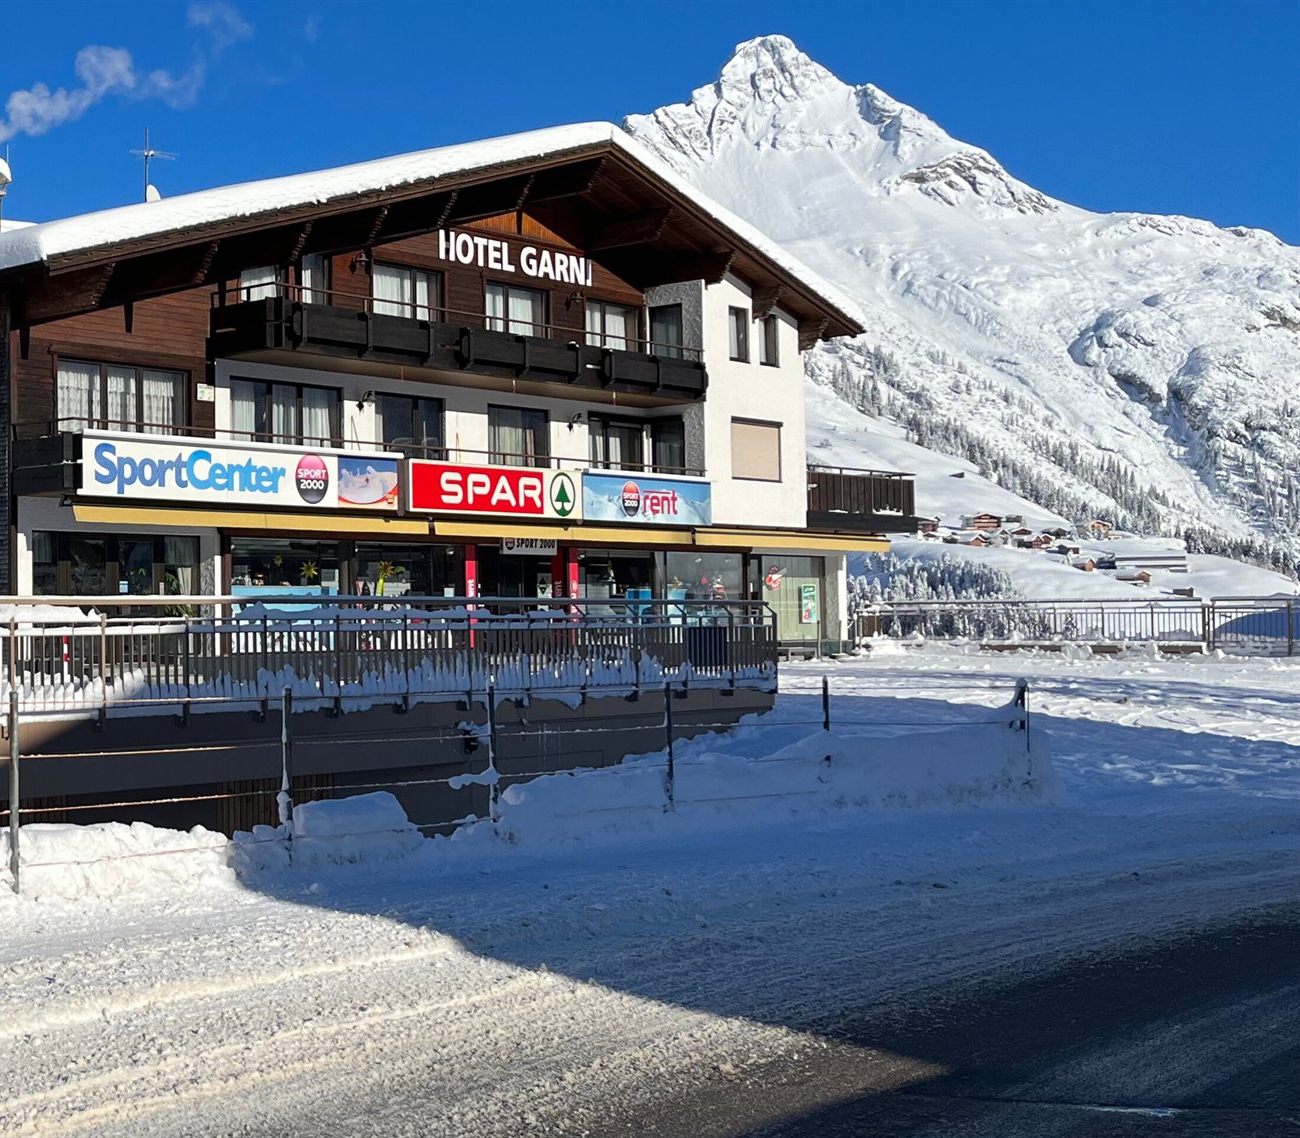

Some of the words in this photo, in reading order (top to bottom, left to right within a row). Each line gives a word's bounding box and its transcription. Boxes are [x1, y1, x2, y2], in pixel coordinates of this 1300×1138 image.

[438, 229, 515, 272] HOTEL
[520, 246, 592, 287] GARNI
[94, 442, 286, 494] SportCenter
[297, 468, 327, 479] SPORT
[300, 480, 325, 489] 2000
[440, 471, 542, 508] SPAR
[643, 490, 677, 515] rent
[516, 537, 538, 549] SPORT
[539, 538, 555, 549] 2000
